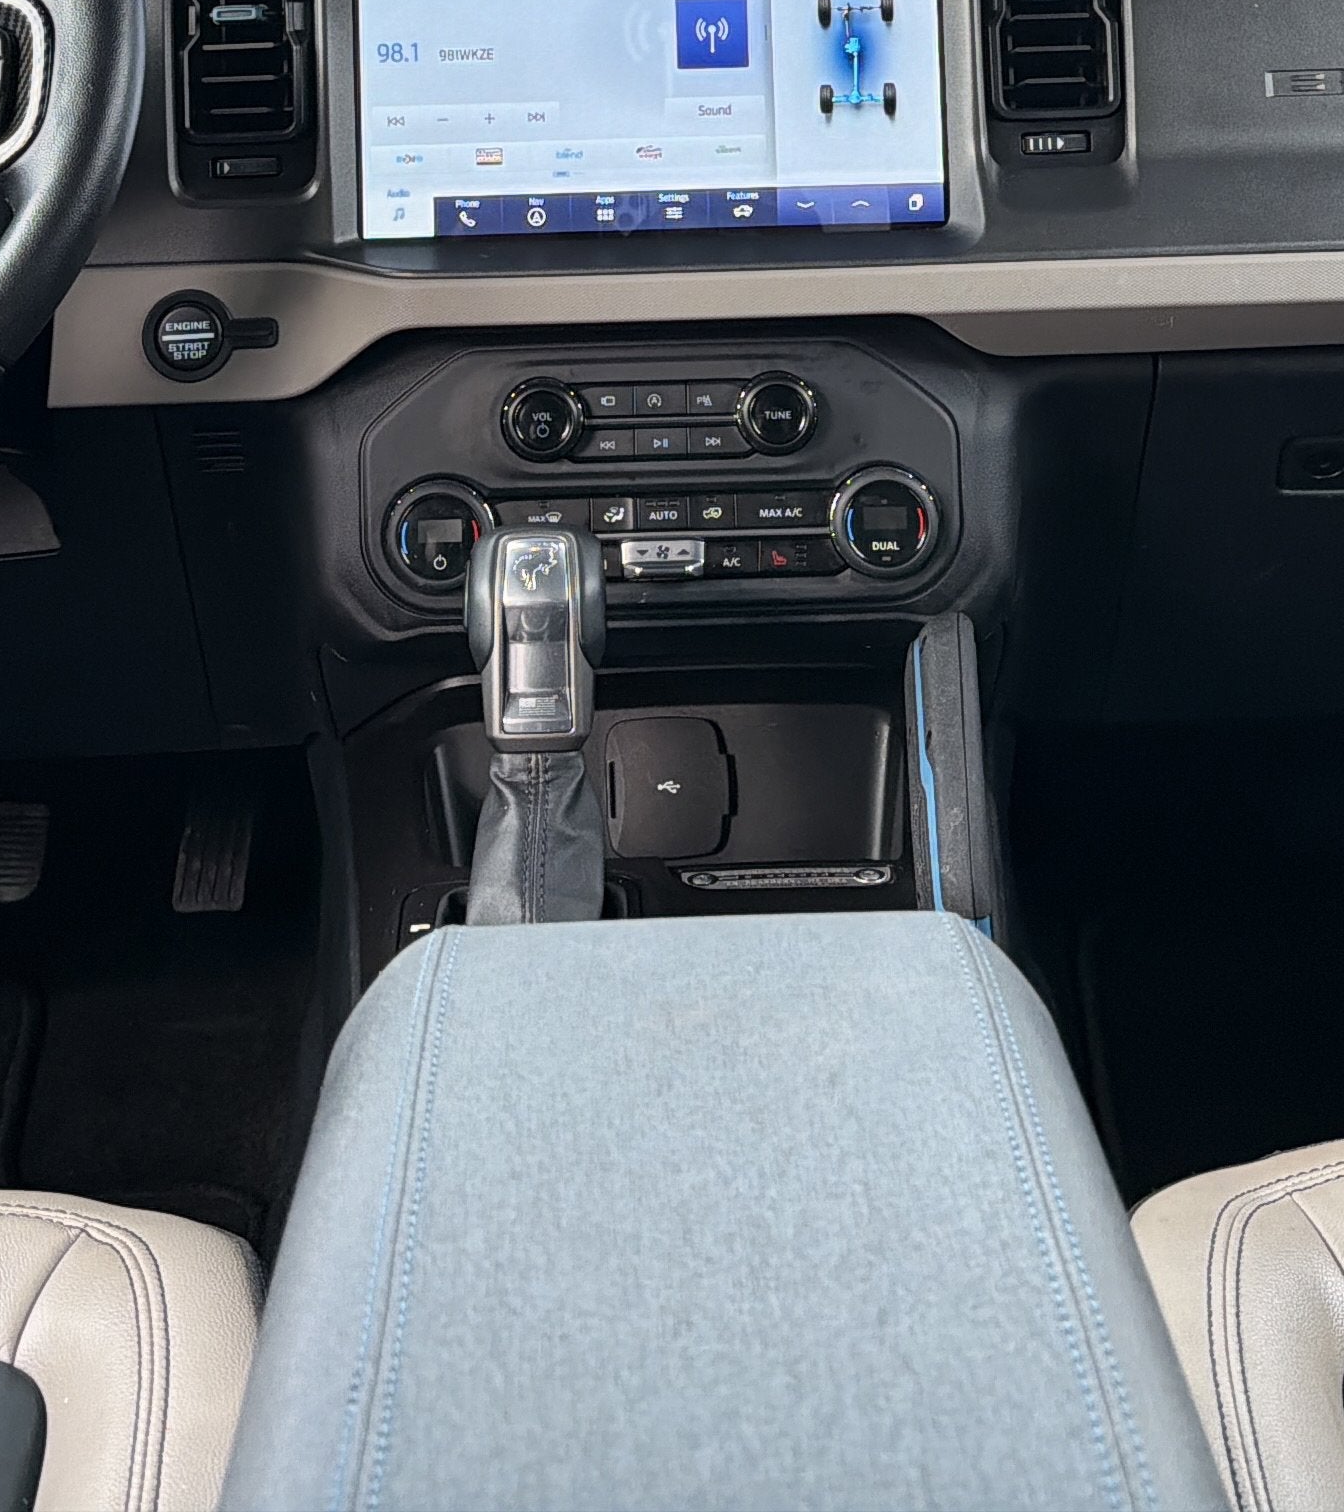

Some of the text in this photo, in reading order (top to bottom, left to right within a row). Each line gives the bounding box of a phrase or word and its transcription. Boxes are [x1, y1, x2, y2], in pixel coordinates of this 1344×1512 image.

[377, 42, 419, 63] 98.1
[697, 103, 732, 117] Sound
[387, 189, 410, 198] Audio
[658, 193, 690, 203] Settings
[726, 191, 759, 201] Features
[456, 199, 480, 209] Phone
[529, 197, 544, 206] Nav
[596, 195, 615, 205] Apps
[165, 321, 211, 331] ENGINE
[168, 342, 210, 352] START
[173, 350, 207, 360] STOP
[532, 412, 552, 421] VOL
[764, 410, 792, 420] TUNE
[649, 510, 678, 520] AUTO
[759, 507, 803, 518] MAX A/C
[528, 515, 545, 523] MAX
[873, 541, 900, 551] DUAL
[723, 557, 741, 568] A/C
